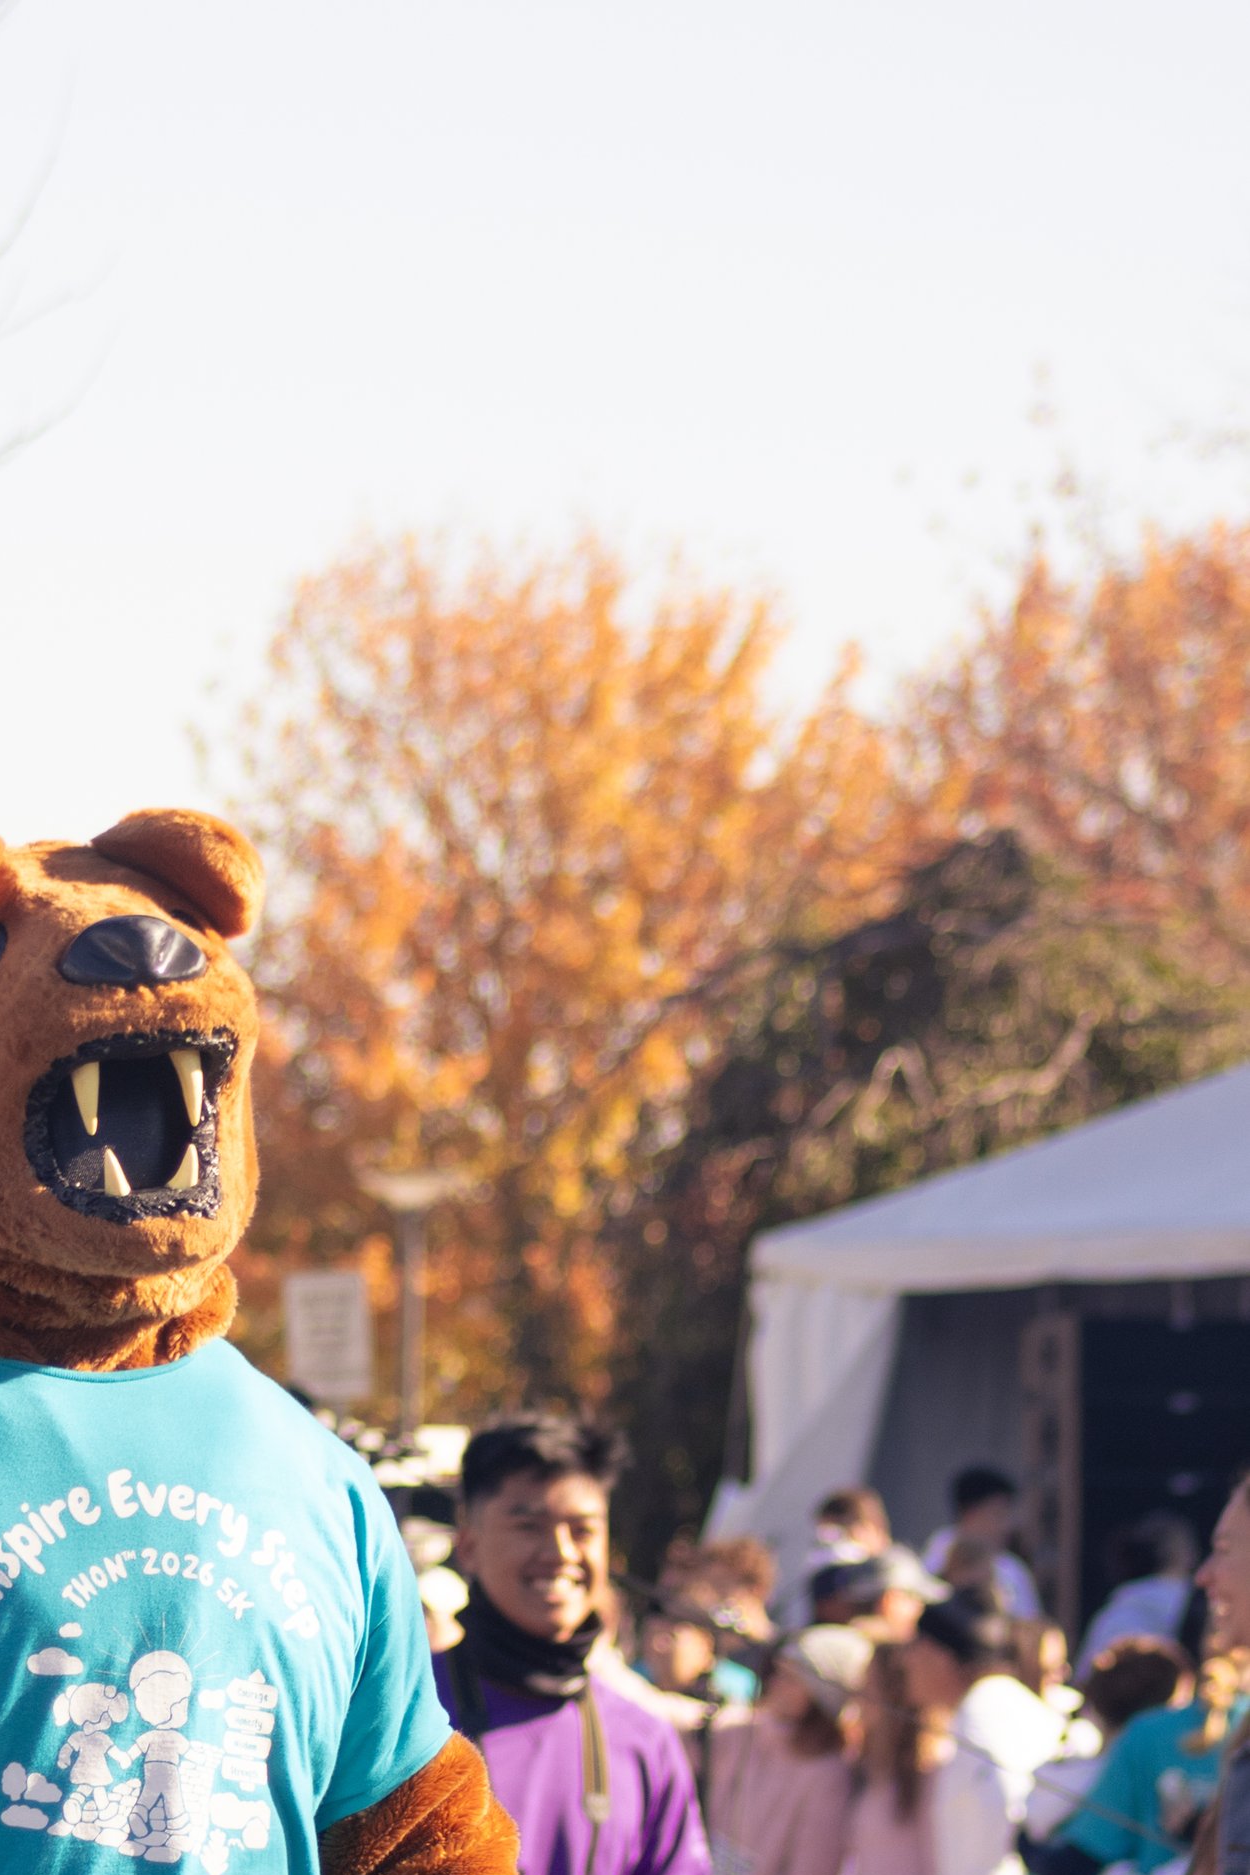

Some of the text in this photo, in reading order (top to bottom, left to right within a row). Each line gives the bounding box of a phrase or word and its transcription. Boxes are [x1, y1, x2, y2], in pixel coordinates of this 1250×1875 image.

[107, 1468, 249, 1558] Every
[251, 1529, 321, 1639] Step
[140, 1547, 216, 1588] 2026
[216, 1577, 255, 1621] 5K
